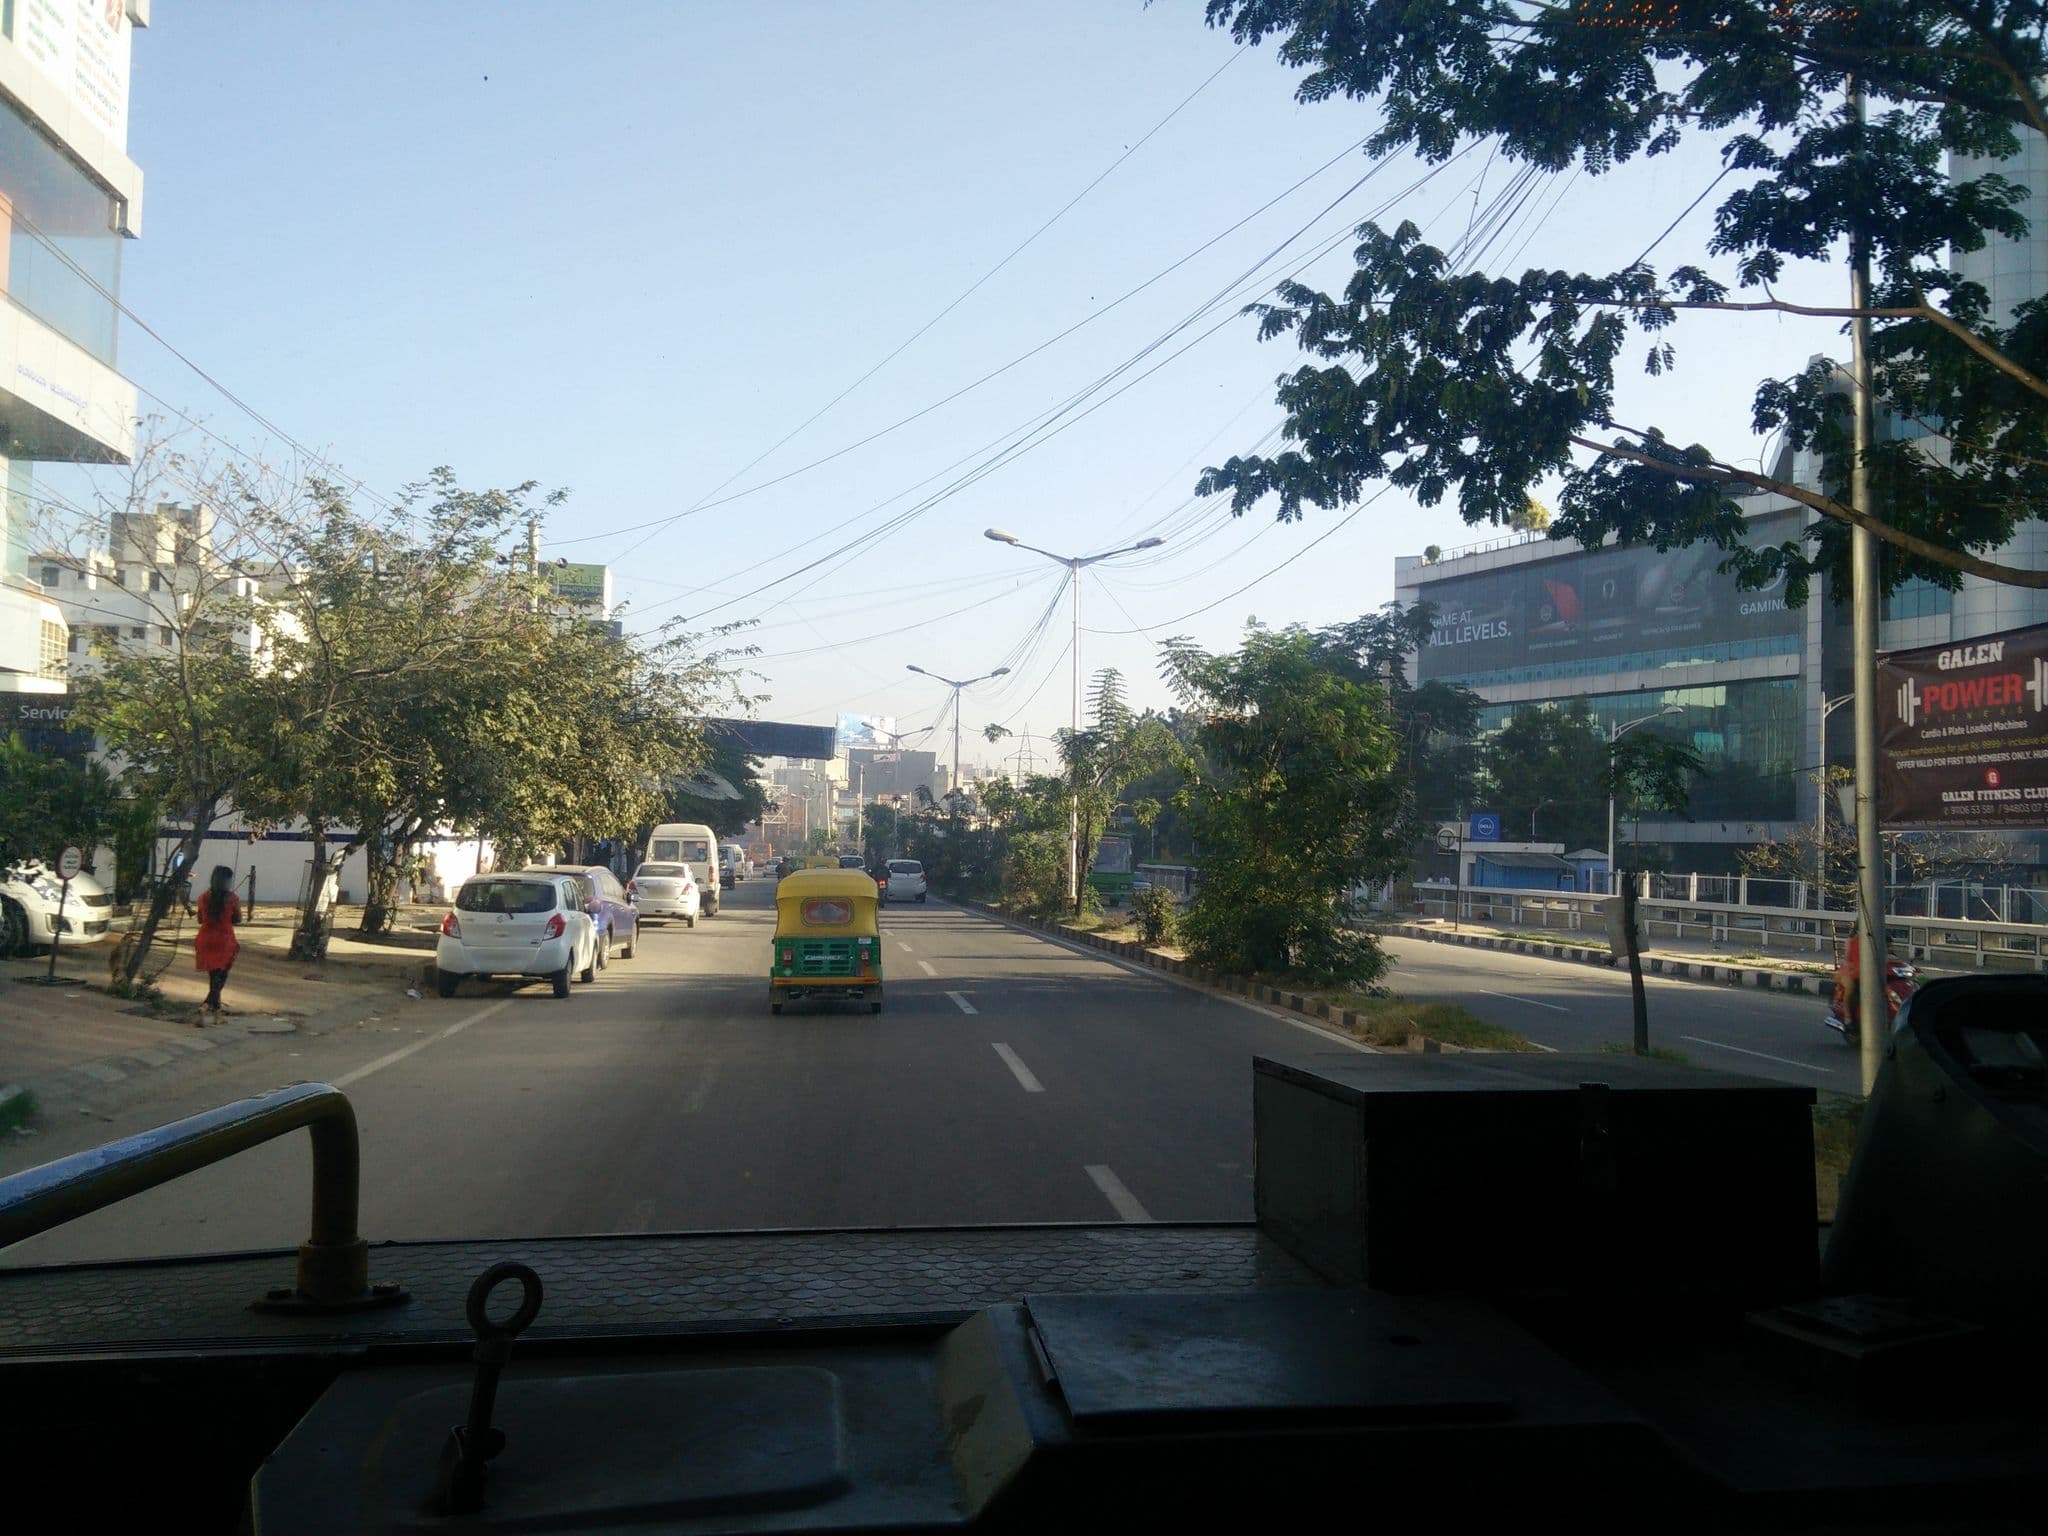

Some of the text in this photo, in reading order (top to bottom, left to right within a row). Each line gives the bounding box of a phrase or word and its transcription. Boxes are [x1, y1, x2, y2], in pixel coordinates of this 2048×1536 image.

[1459, 609, 1473, 624] AT
[1429, 621, 1511, 648] ALL LEVELS.
[1938, 641, 2004, 671] GALEN
[1923, 673, 2024, 716] POWER
[1948, 726, 1965, 736] Plate
[1966, 722, 1993, 734] Loaded
[1895, 760, 1915, 770] OFFER
[1916, 759, 1934, 768] VALID
[1942, 790, 1974, 802] GALEN
[1976, 788, 2020, 801] FITNESS
